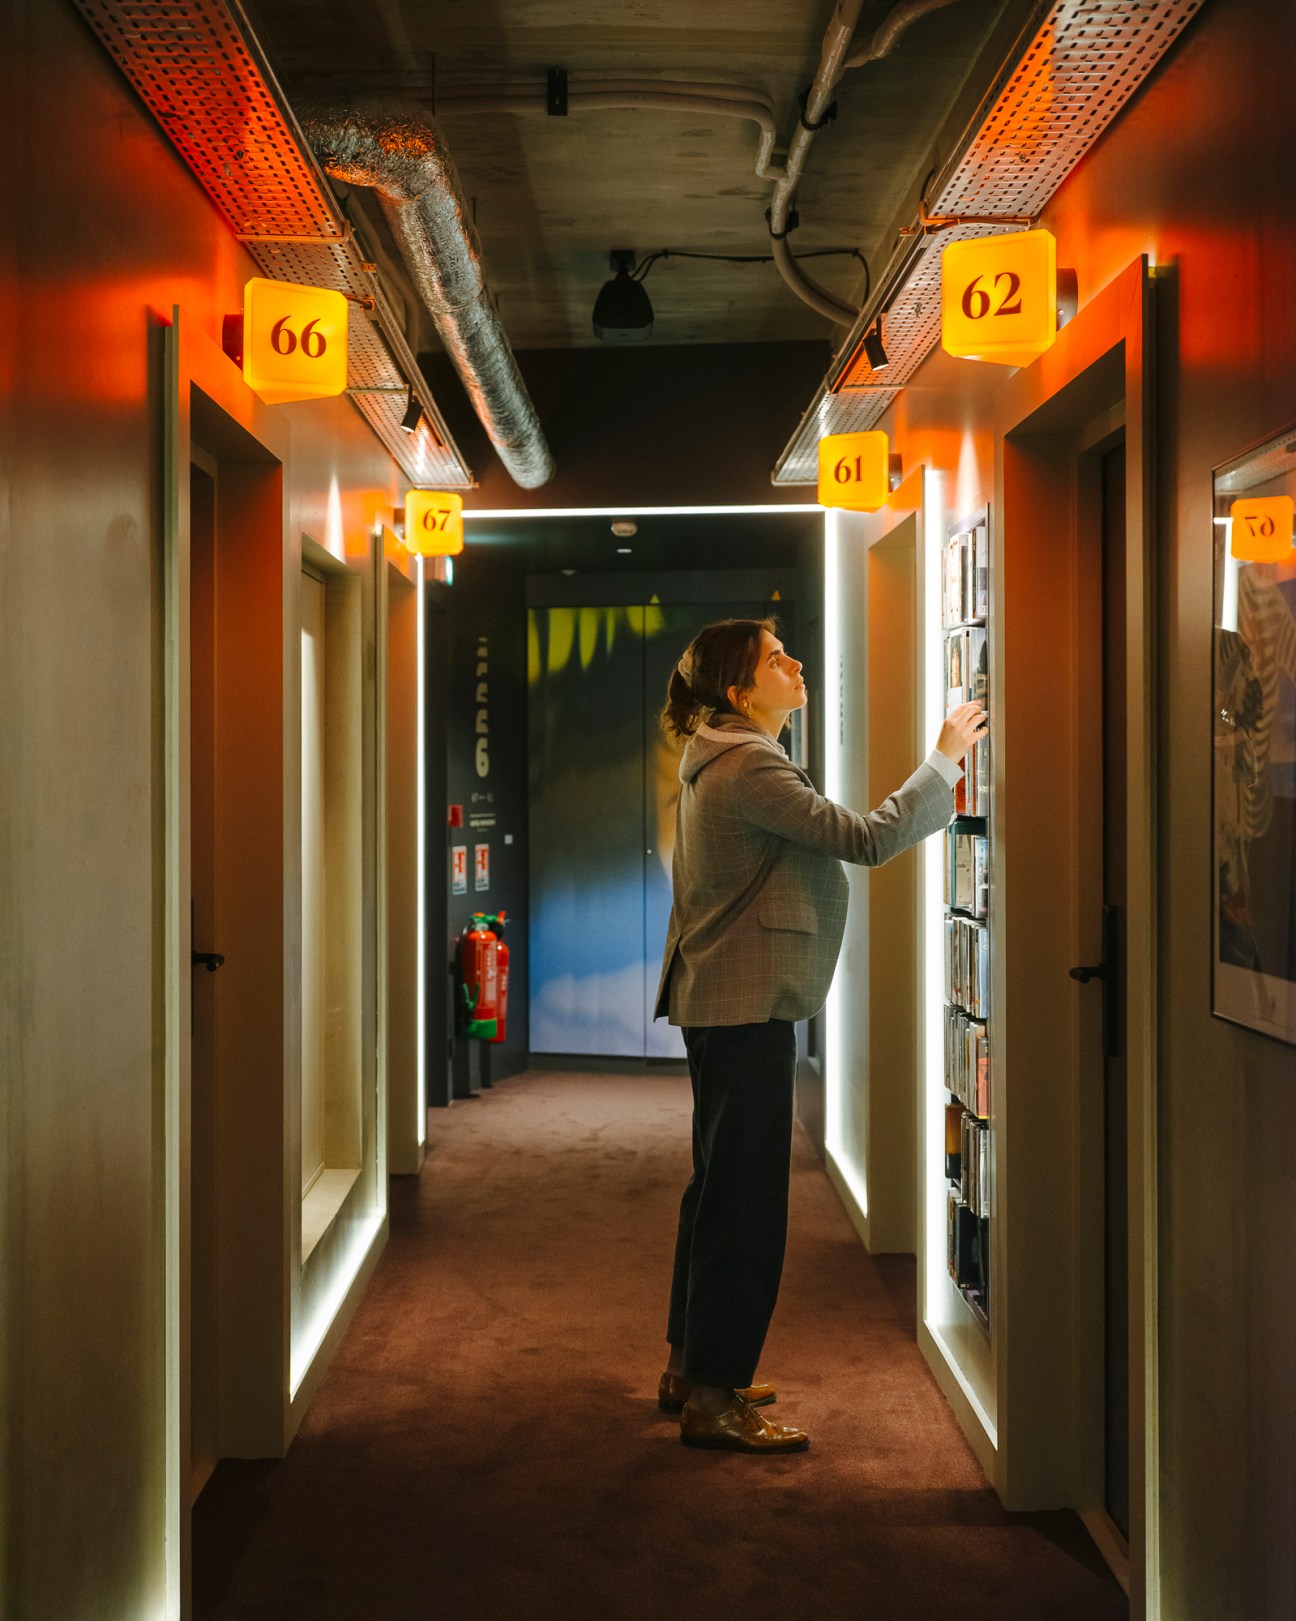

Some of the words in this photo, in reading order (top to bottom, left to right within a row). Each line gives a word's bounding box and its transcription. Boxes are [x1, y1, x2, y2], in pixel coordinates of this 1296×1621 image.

[962, 271, 1022, 320] 62
[270, 315, 327, 358] 66
[834, 455, 862, 484] 61
[423, 508, 452, 531] 67
